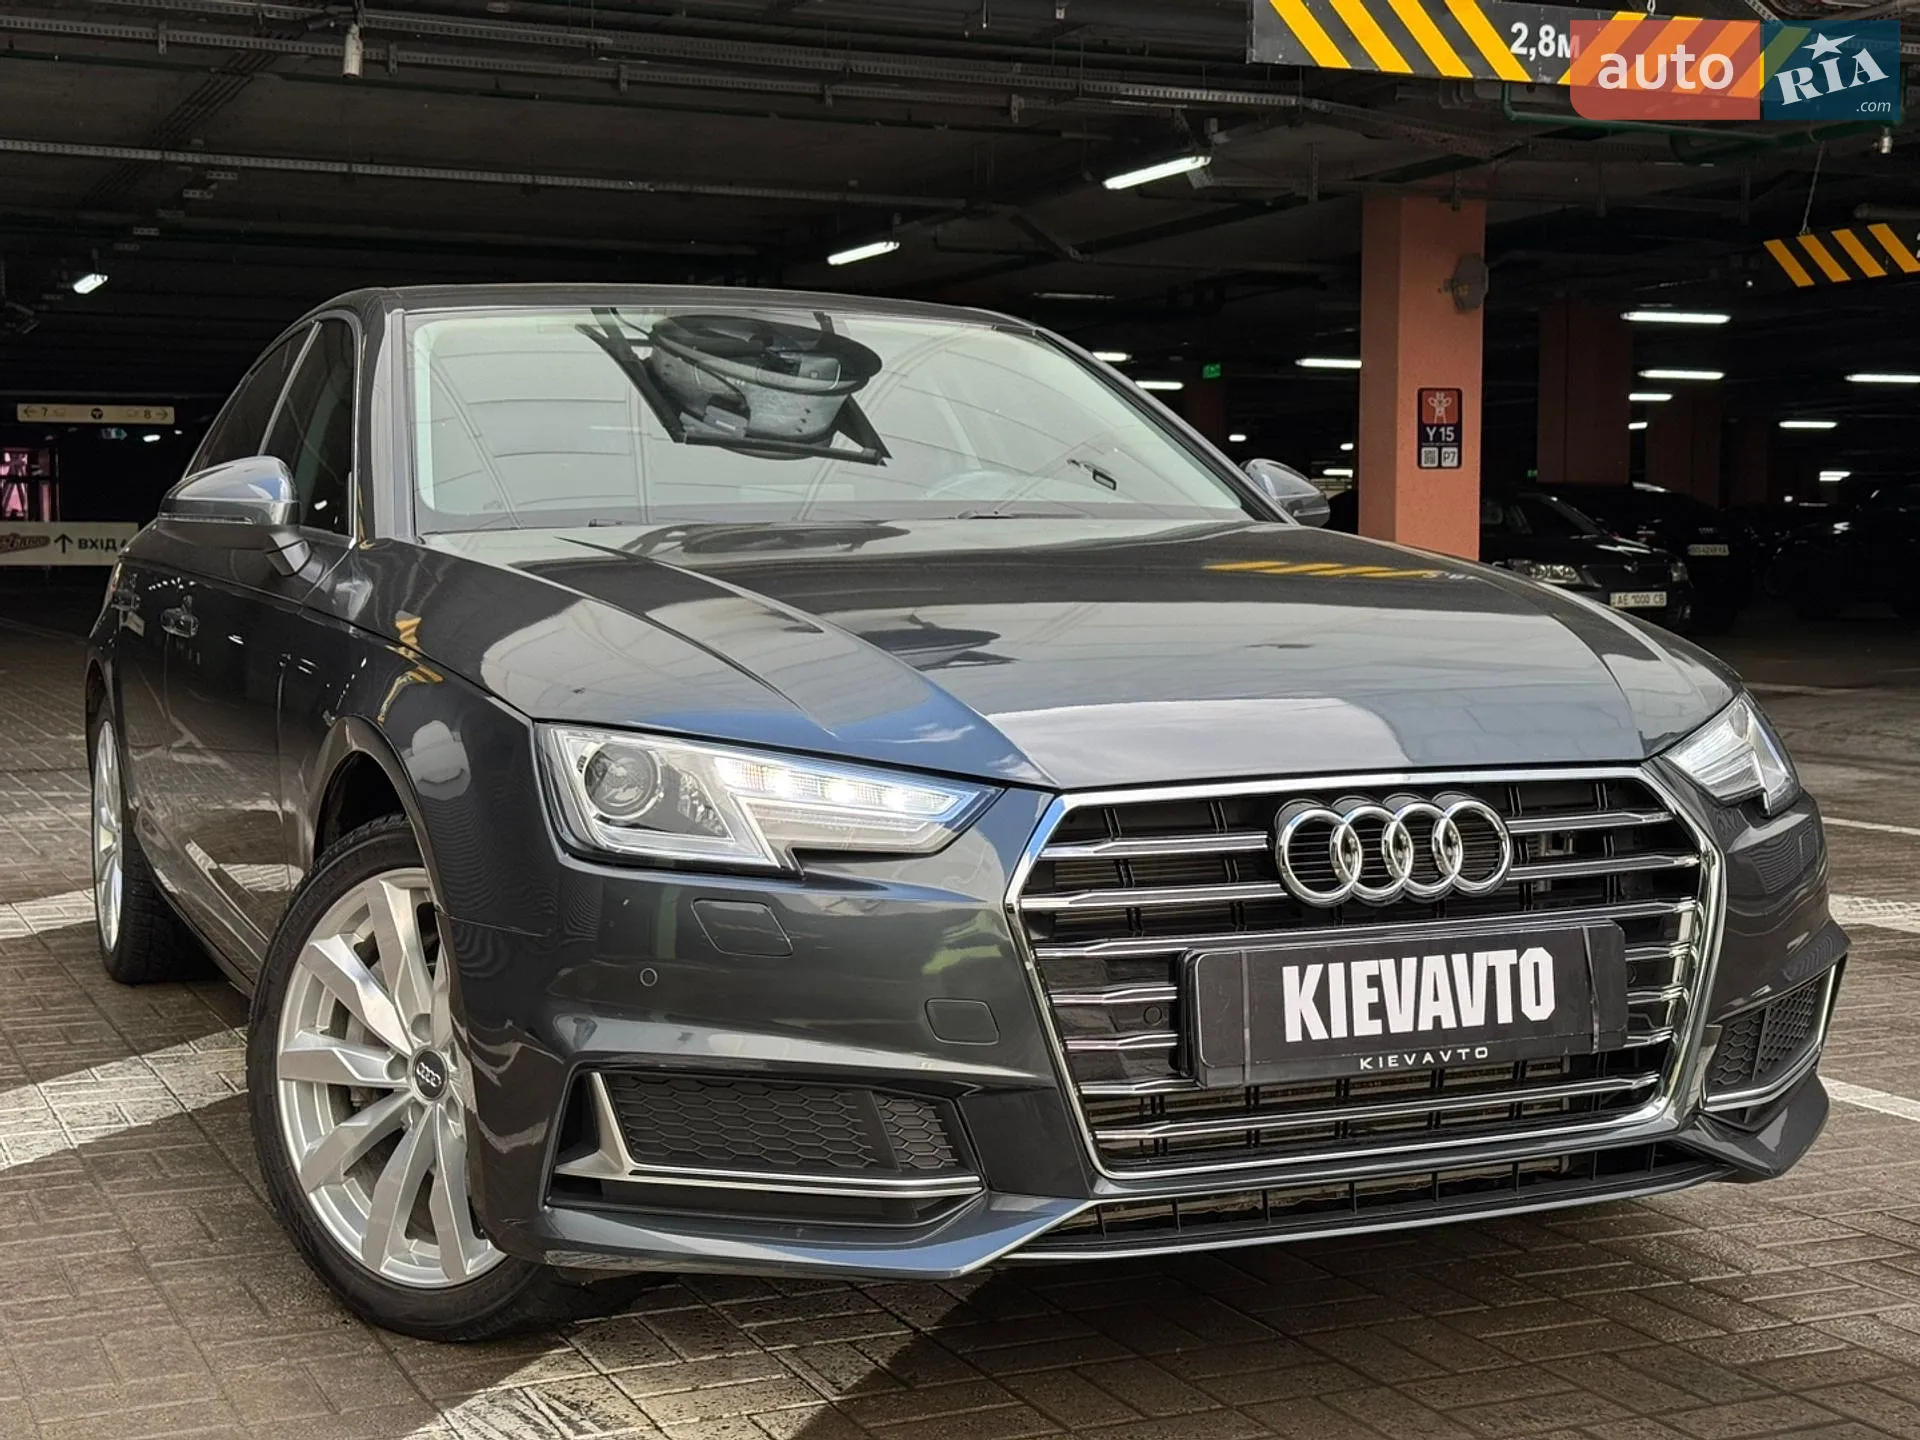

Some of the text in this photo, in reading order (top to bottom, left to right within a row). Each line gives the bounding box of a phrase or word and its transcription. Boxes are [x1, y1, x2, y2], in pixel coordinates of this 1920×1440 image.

[1426, 426, 1455, 442] Y 15
[1282, 946, 1556, 1043] KIEVAVTO
[1359, 1046, 1489, 1071] KIEVAVTO
